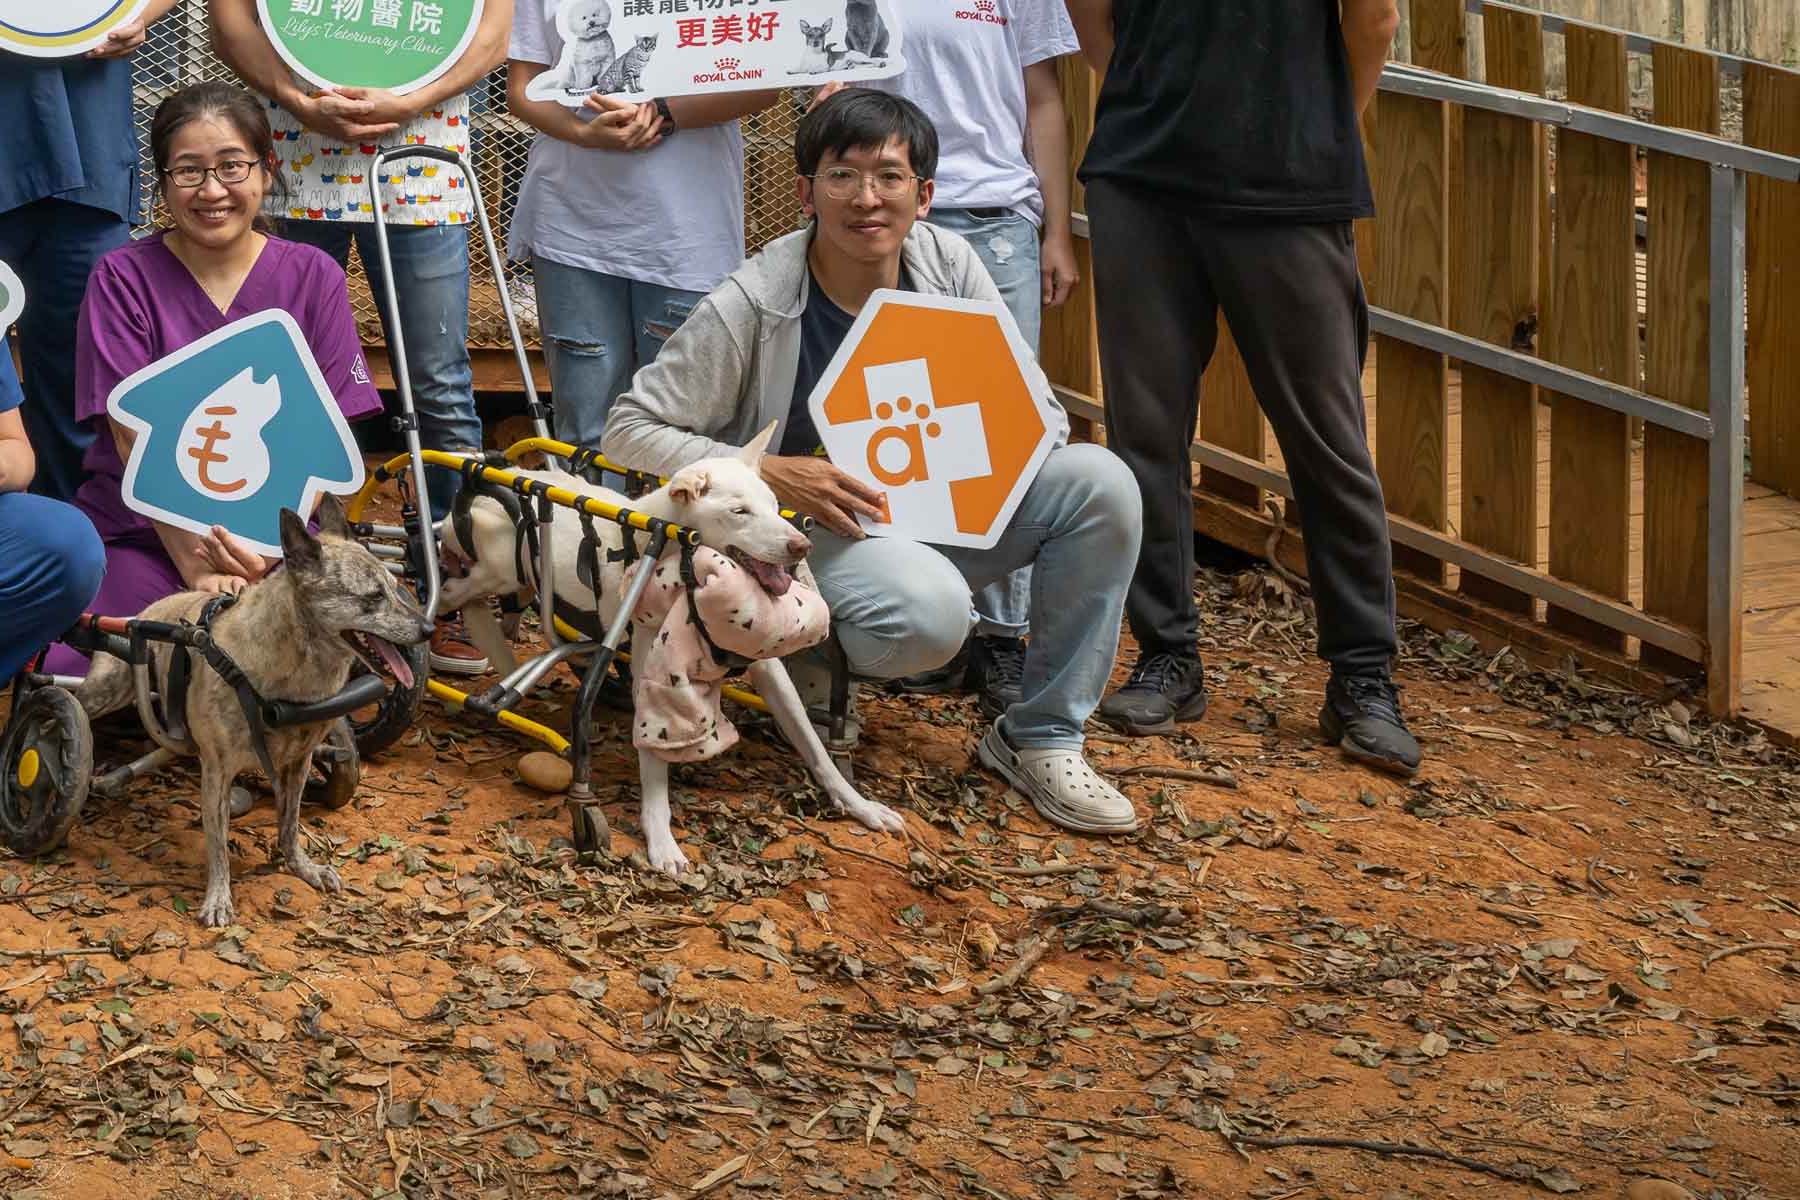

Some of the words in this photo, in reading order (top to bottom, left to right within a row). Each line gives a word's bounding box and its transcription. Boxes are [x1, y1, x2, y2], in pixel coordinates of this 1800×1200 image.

[955, 11, 984, 21] ROYAL
[322, 23, 400, 55] Veterinary
[401, 36, 444, 54] Clinic
[675, 11, 781, 49] 更美好
[693, 72, 725, 84] ROYAL
[729, 69, 763, 81] CANIN
